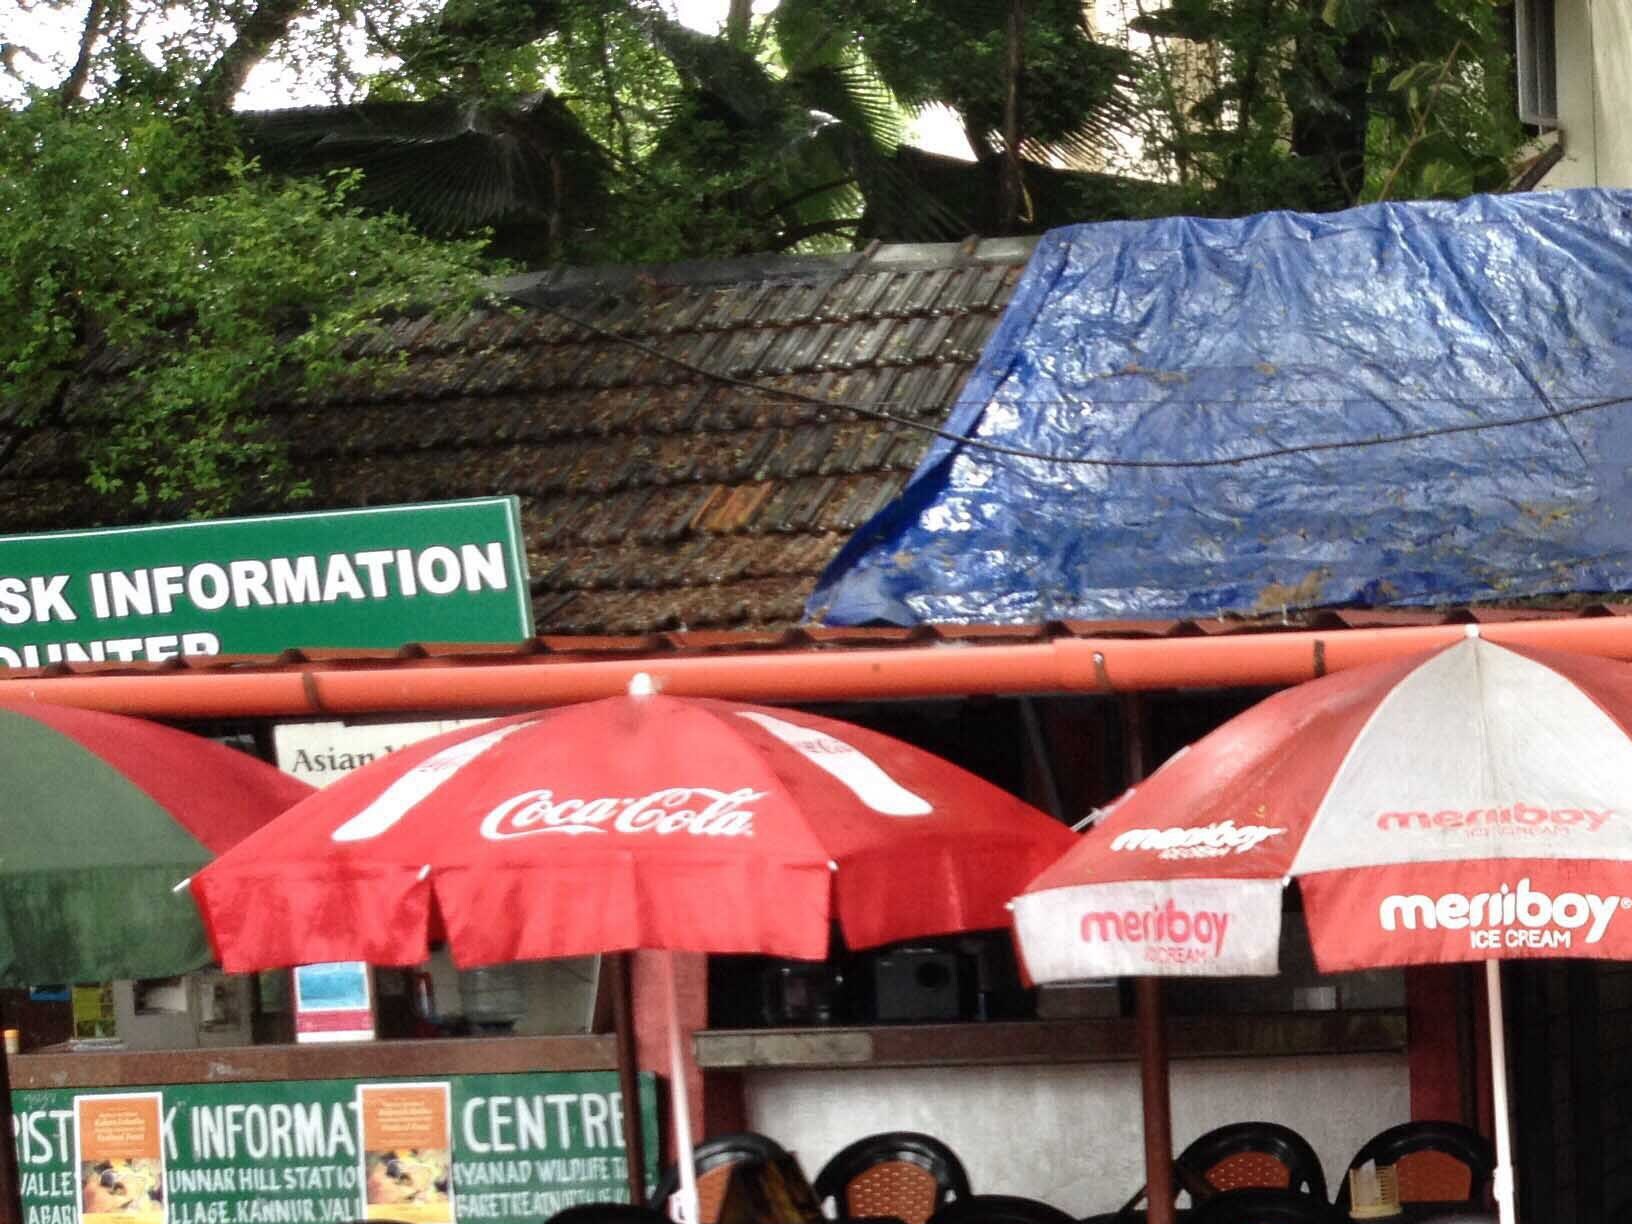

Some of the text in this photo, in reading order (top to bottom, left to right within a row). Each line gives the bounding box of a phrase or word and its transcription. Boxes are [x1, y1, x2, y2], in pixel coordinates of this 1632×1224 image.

[91, 542, 508, 618] INFORMATION
[292, 747, 375, 773] Asian
[1470, 929, 1572, 949] ICE CREAM
[191, 1101, 358, 1161] INFORMA
[463, 1092, 626, 1153] CENTRE
[20, 1171, 77, 1197] VALLE
[169, 1168, 236, 1192] UNNAR
[239, 1167, 281, 1191] HILL
[284, 1165, 360, 1190] STATIO
